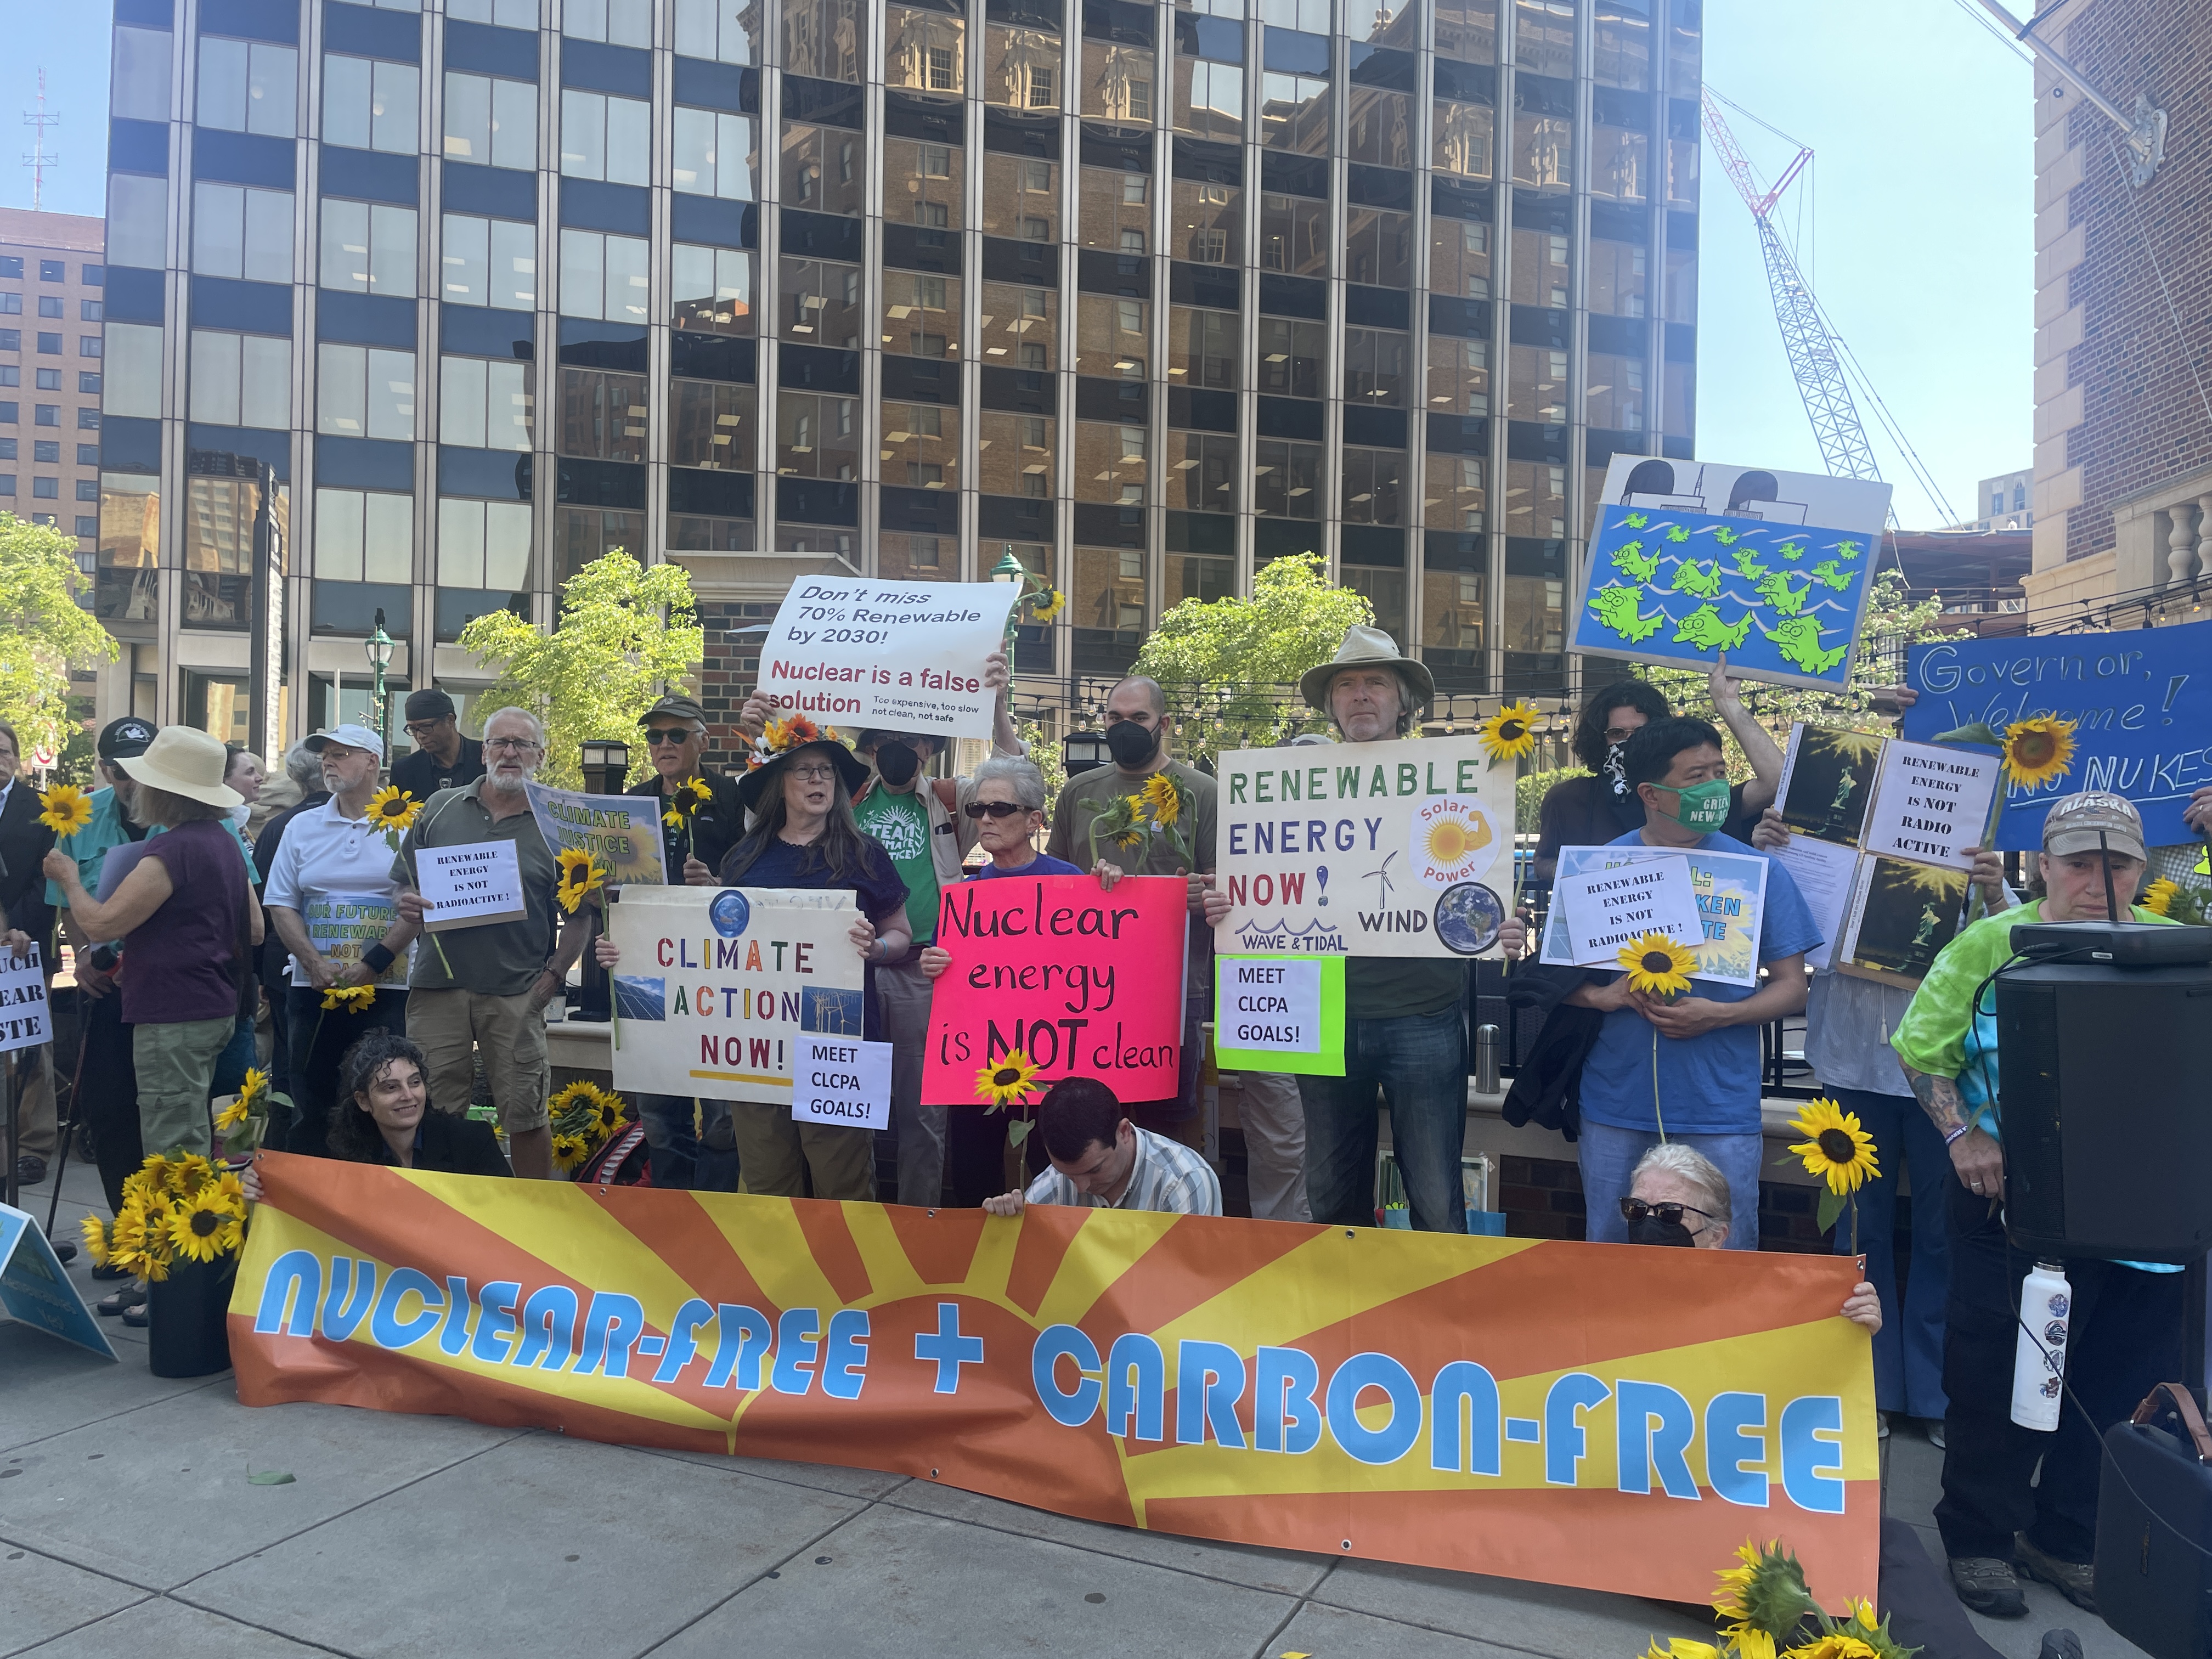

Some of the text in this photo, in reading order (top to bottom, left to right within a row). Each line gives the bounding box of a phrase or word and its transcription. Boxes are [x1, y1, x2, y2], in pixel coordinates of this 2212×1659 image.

[799, 586, 932, 604] Don't miss
[798, 606, 981, 624] 70% Renewable
[787, 626, 888, 645] by 2030!
[771, 660, 980, 693] Nuclear is a false
[1920, 645, 2152, 694] Governor,
[769, 690, 861, 713] solution
[873, 696, 979, 714] Too expensive, too slow
[872, 707, 954, 723] not clean, not safe
[1902, 755, 1980, 778] RENEWABLE
[1229, 759, 1480, 805] RENEWABLE
[1911, 776, 1962, 793] ENERGY
[1420, 799, 1469, 821] Solar
[1907, 795, 1957, 813] IS NOT
[2059, 797, 2134, 820] ALASKA
[548, 801, 630, 830] CLIMATE
[1690, 810, 1716, 822] NEW
[1901, 815, 1953, 836] RADIO
[557, 826, 630, 854] JUSTICE
[869, 823, 915, 841] TEAM
[1229, 817, 1383, 855] ENERGY
[437, 850, 498, 865] RENEWABLE
[1892, 837, 1950, 859] ACTIVE
[449, 865, 489, 877] ENERGY
[1424, 861, 1476, 883] Power
[454, 879, 488, 891] IS NOT
[1228, 865, 1329, 907] NOW!
[1587, 871, 1665, 895] RENEWABLE
[436, 894, 504, 910] RADIOACTIVE
[1602, 890, 1653, 909] ENERGY
[308, 904, 397, 922] OUR FUTURE
[941, 883, 1139, 940] Nuclear
[1357, 909, 1428, 933] WIND
[1609, 909, 1654, 926] IS NOT
[312, 924, 391, 940] RENEWAB
[330, 944, 362, 958] NOT
[1242, 934, 1349, 952] WAVE & TIDAL
[657, 937, 814, 974] CLIMATE
[1238, 968, 1285, 984] MEET
[968, 964, 1115, 1014] energy
[673, 985, 800, 1023] ACTION
[1238, 996, 1289, 1014] CLCPA
[1237, 1024, 1300, 1043] GOALS!
[701, 1034, 784, 1070] NOW!
[812, 1045, 858, 1063] MEET
[941, 1018, 1173, 1071] is NOT clean
[811, 1071, 861, 1091] CLCPA
[810, 1098, 871, 1119] GOALS!
[253, 1249, 871, 1401] NUCLEAR-FREE
[1032, 1323, 1846, 1515] CARBON-FREE
